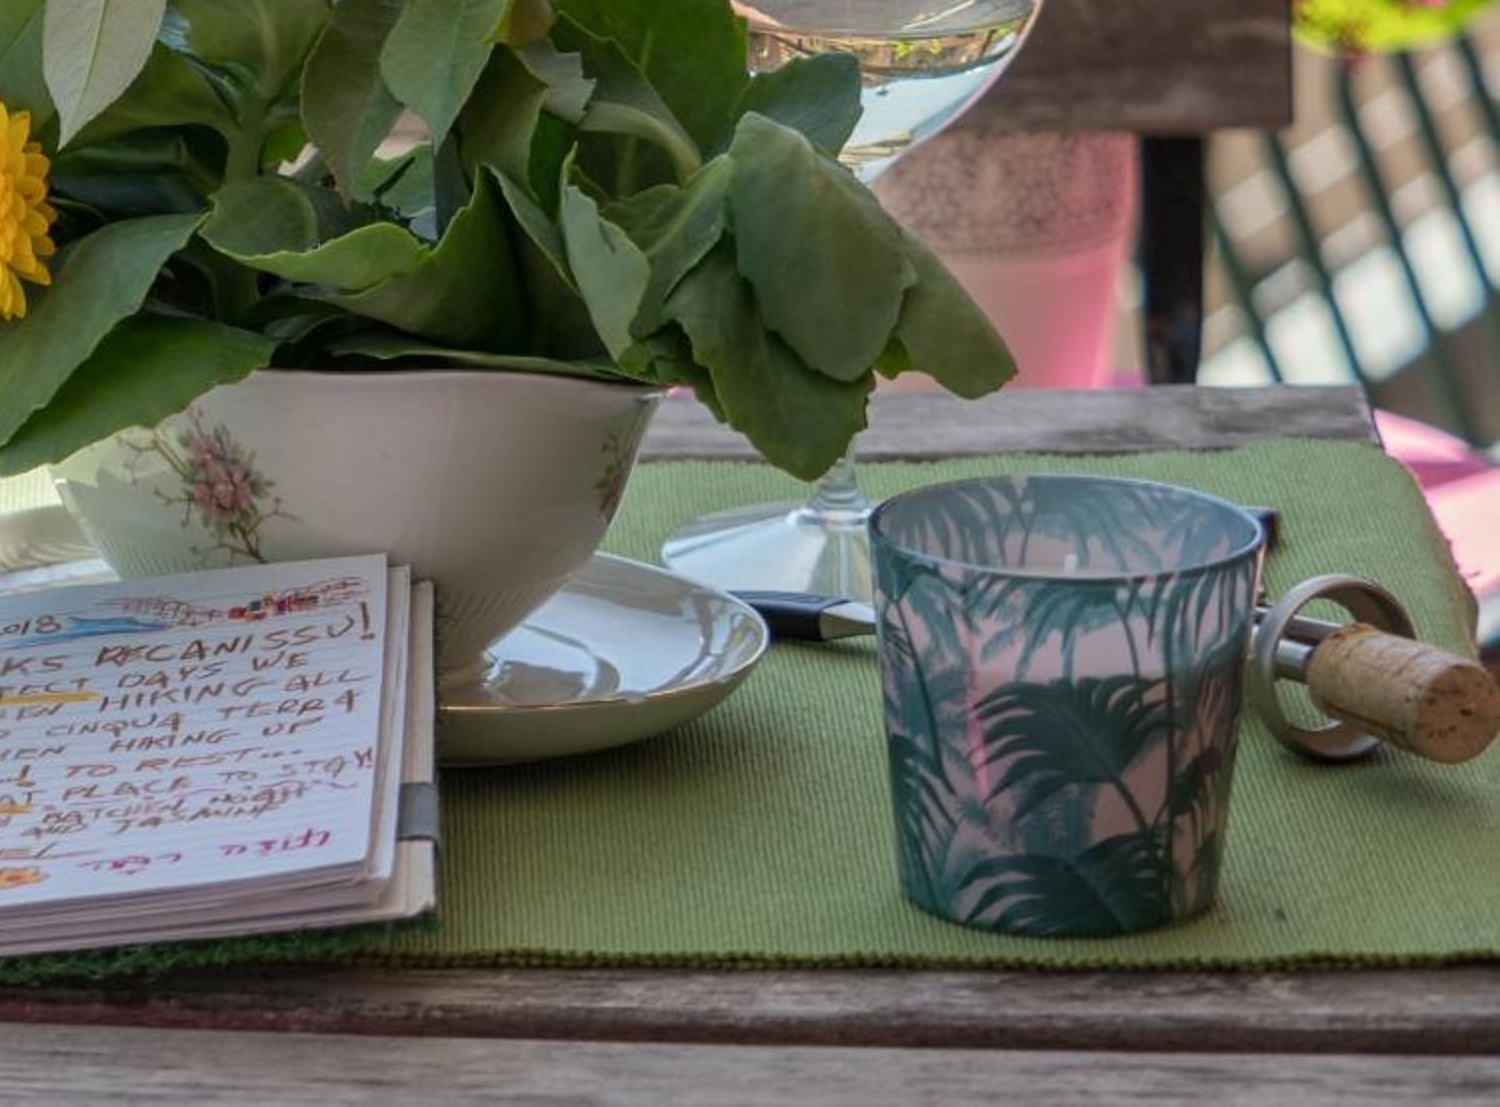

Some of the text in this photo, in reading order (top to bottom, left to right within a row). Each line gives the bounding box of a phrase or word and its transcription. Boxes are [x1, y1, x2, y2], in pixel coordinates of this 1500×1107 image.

[118, 660, 228, 688] DAYS
[252, 651, 309, 672] WE
[99, 678, 269, 712] HIKING
[284, 669, 371, 692] ALL
[108, 728, 240, 752] HIKING
[62, 774, 191, 801] PLACE
[217, 770, 258, 783] TO
[67, 764, 117, 778] TO
